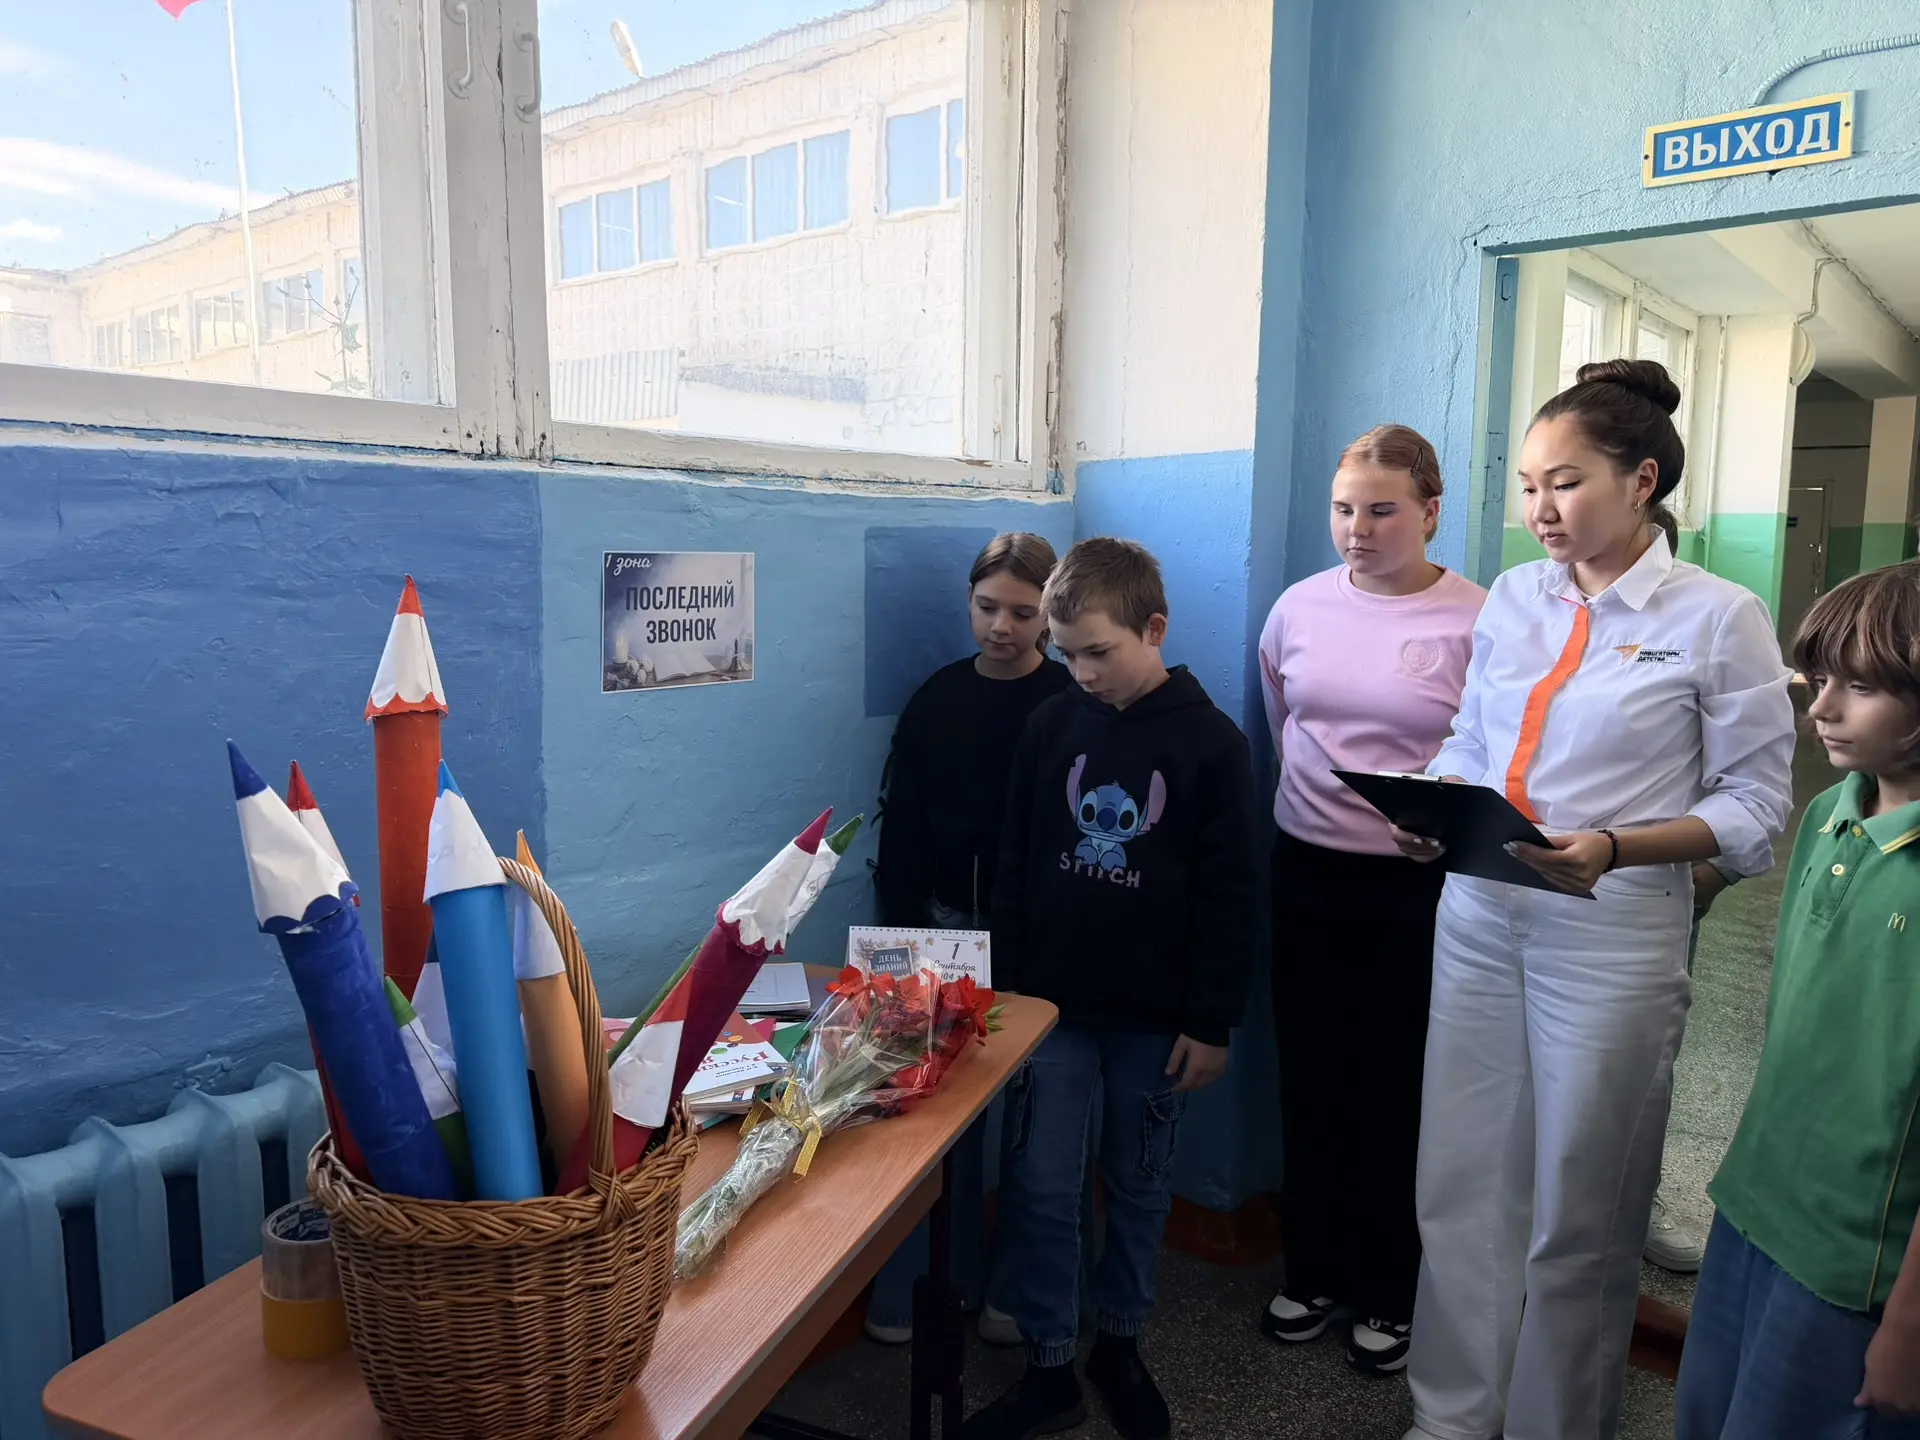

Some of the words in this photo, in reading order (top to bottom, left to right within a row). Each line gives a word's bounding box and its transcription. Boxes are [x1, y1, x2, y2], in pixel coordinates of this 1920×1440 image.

[1663, 111, 1831, 171] ВЫХОД
[605, 554, 613, 568] 1
[613, 556, 652, 576] зона
[625, 579, 734, 613] ПОСЛЕДНИЙ
[645, 617, 717, 644] ЗВОНОК
[878, 953, 902, 963] ДЕНЬ
[951, 942, 960, 960] 1
[874, 961, 908, 972] ЗНАНИЙ
